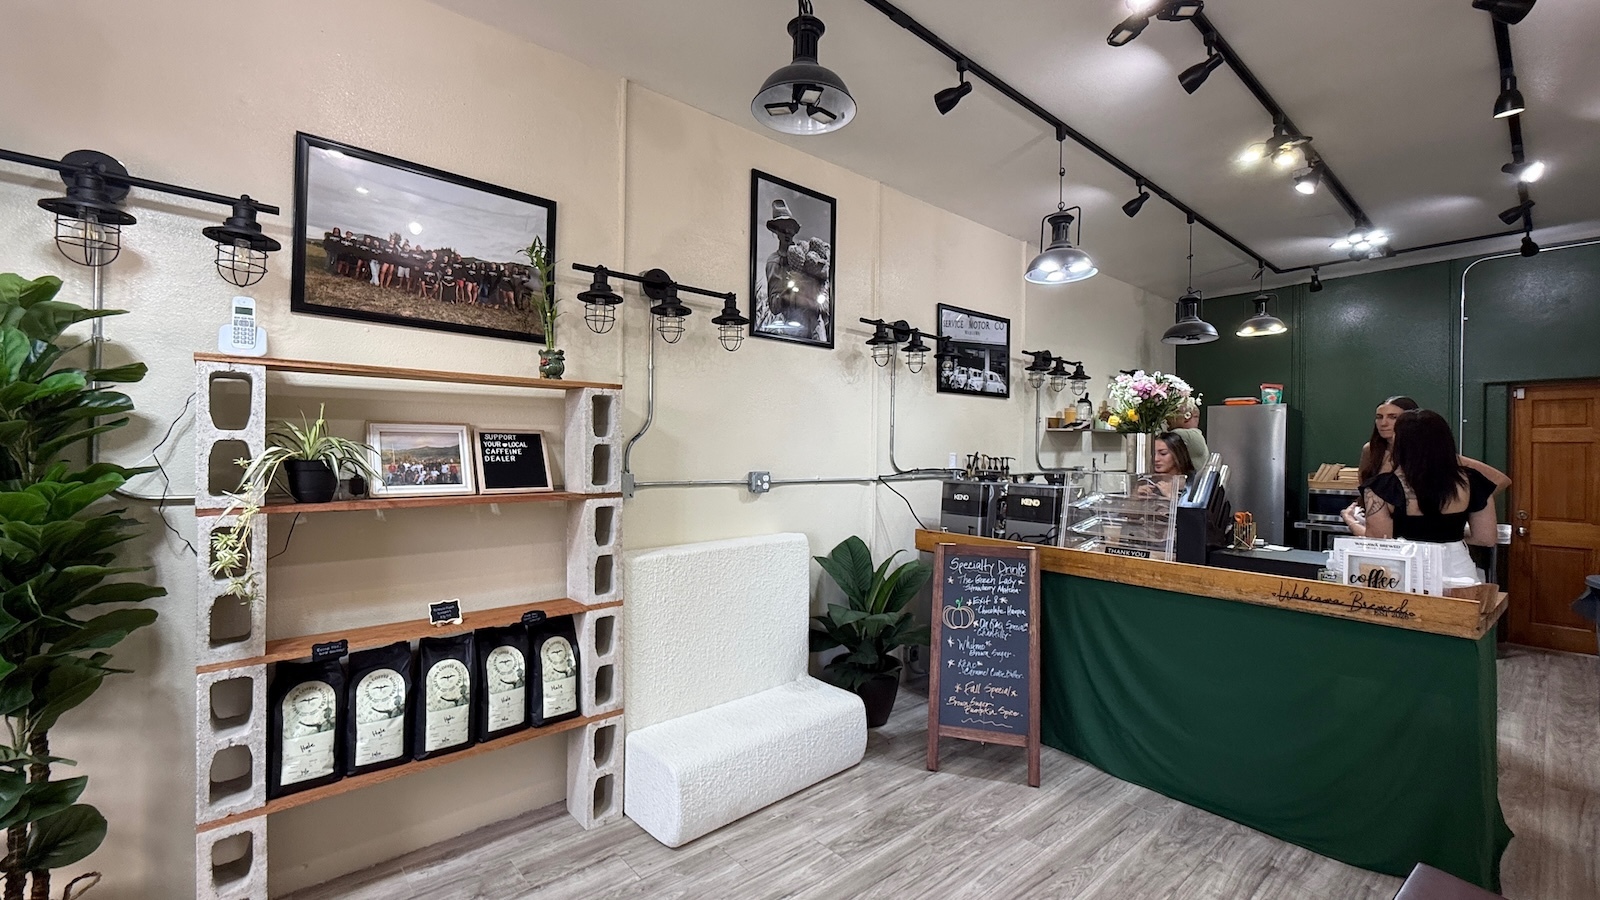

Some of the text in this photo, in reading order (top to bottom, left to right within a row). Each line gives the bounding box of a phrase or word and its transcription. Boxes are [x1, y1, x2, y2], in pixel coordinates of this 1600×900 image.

[943, 319, 1005, 331] SERVICE MOTOR CO
[1020, 498, 1041, 507] KENO
[1107, 548, 1131, 556] THANK
[949, 557, 1027, 577] Specialty Drinks
[957, 573, 1017, 588] The Green Lady
[1349, 568, 1400, 589] coffee
[972, 596, 991, 605] Exit
[1350, 590, 1411, 613] Brewed
[964, 681, 1012, 699] Fall Special
